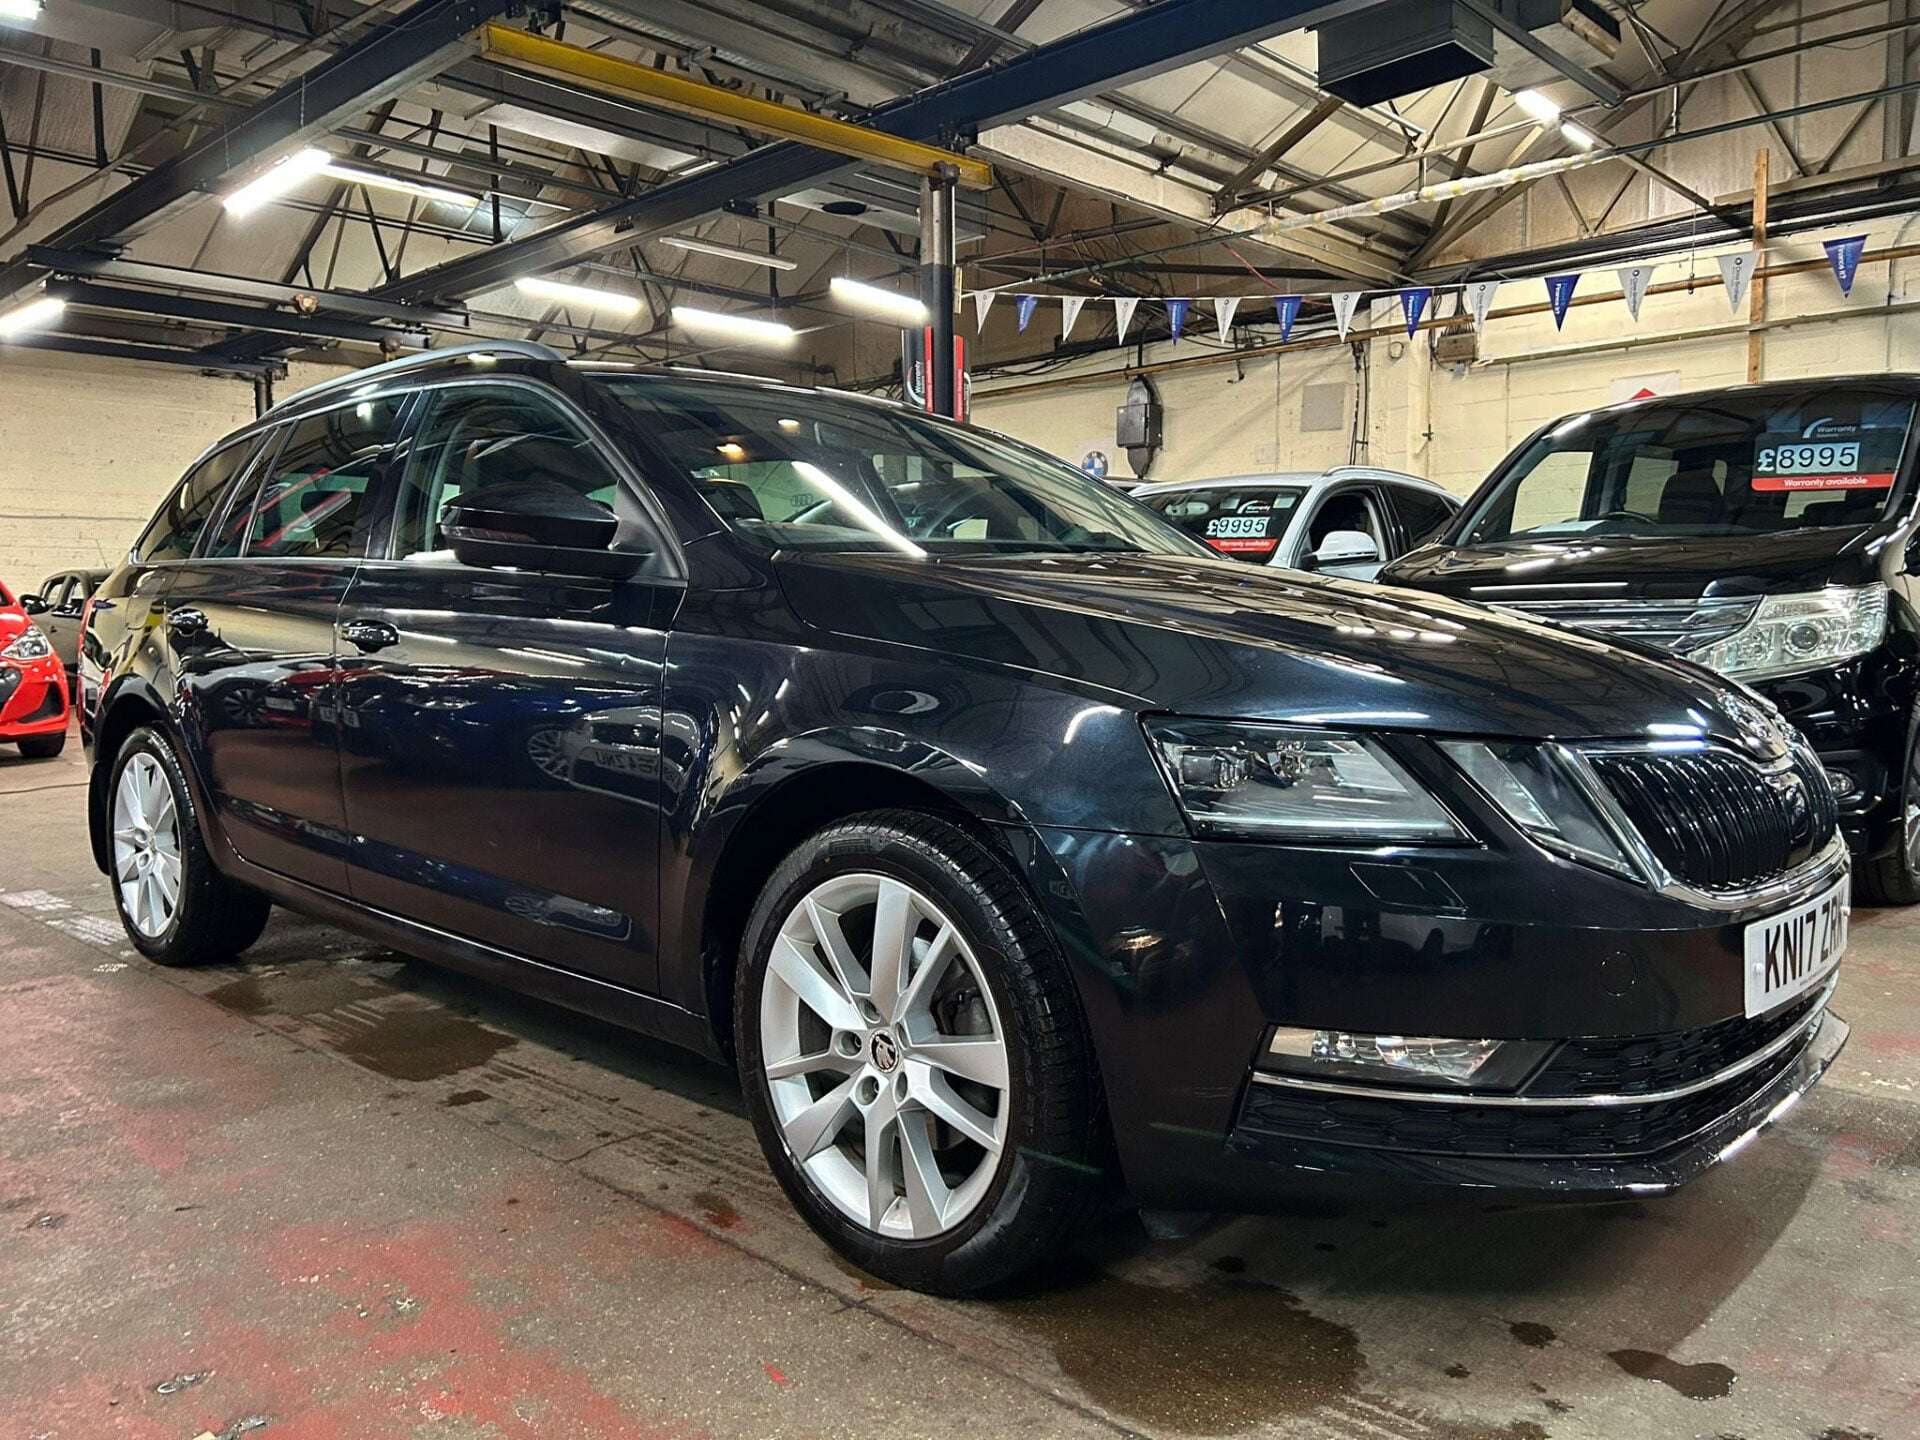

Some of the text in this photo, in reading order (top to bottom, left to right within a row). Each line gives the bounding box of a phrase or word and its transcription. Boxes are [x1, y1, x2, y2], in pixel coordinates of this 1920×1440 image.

[1816, 425, 1856, 433] Warranty
[1757, 446, 1857, 471] £8995
[1783, 476, 1868, 488] Warranty available
[1206, 519, 1267, 536] £9995
[1765, 909, 1817, 993] KN17
